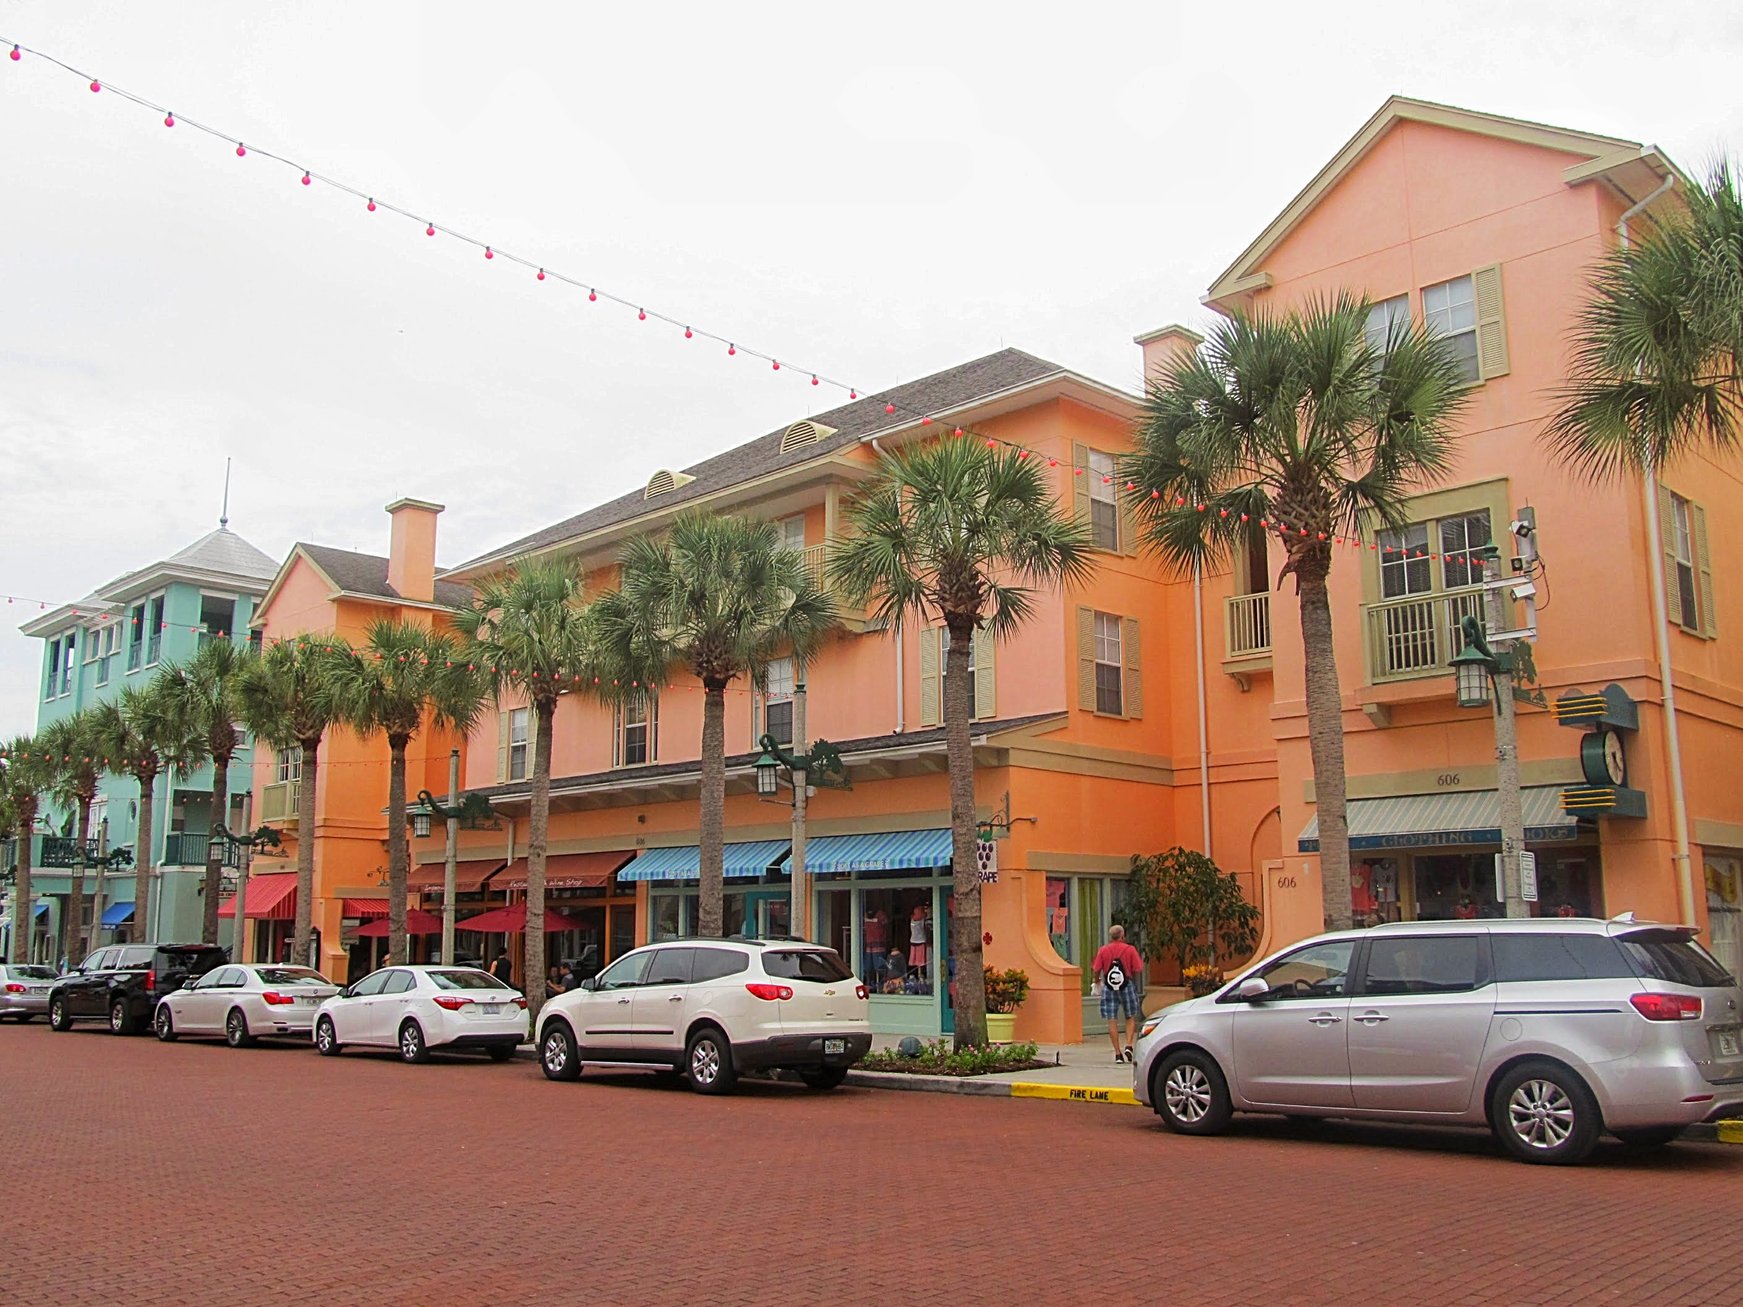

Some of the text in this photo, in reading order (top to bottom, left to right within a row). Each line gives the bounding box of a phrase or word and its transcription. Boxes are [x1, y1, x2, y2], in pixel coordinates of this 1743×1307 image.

[1437, 773, 1460, 786] 606
[1382, 831, 1472, 847] CLOTHING
[977, 871, 998, 883] RAPE
[1277, 876, 1297, 889] 606
[1070, 1089, 1109, 1101] FIRE LANE
